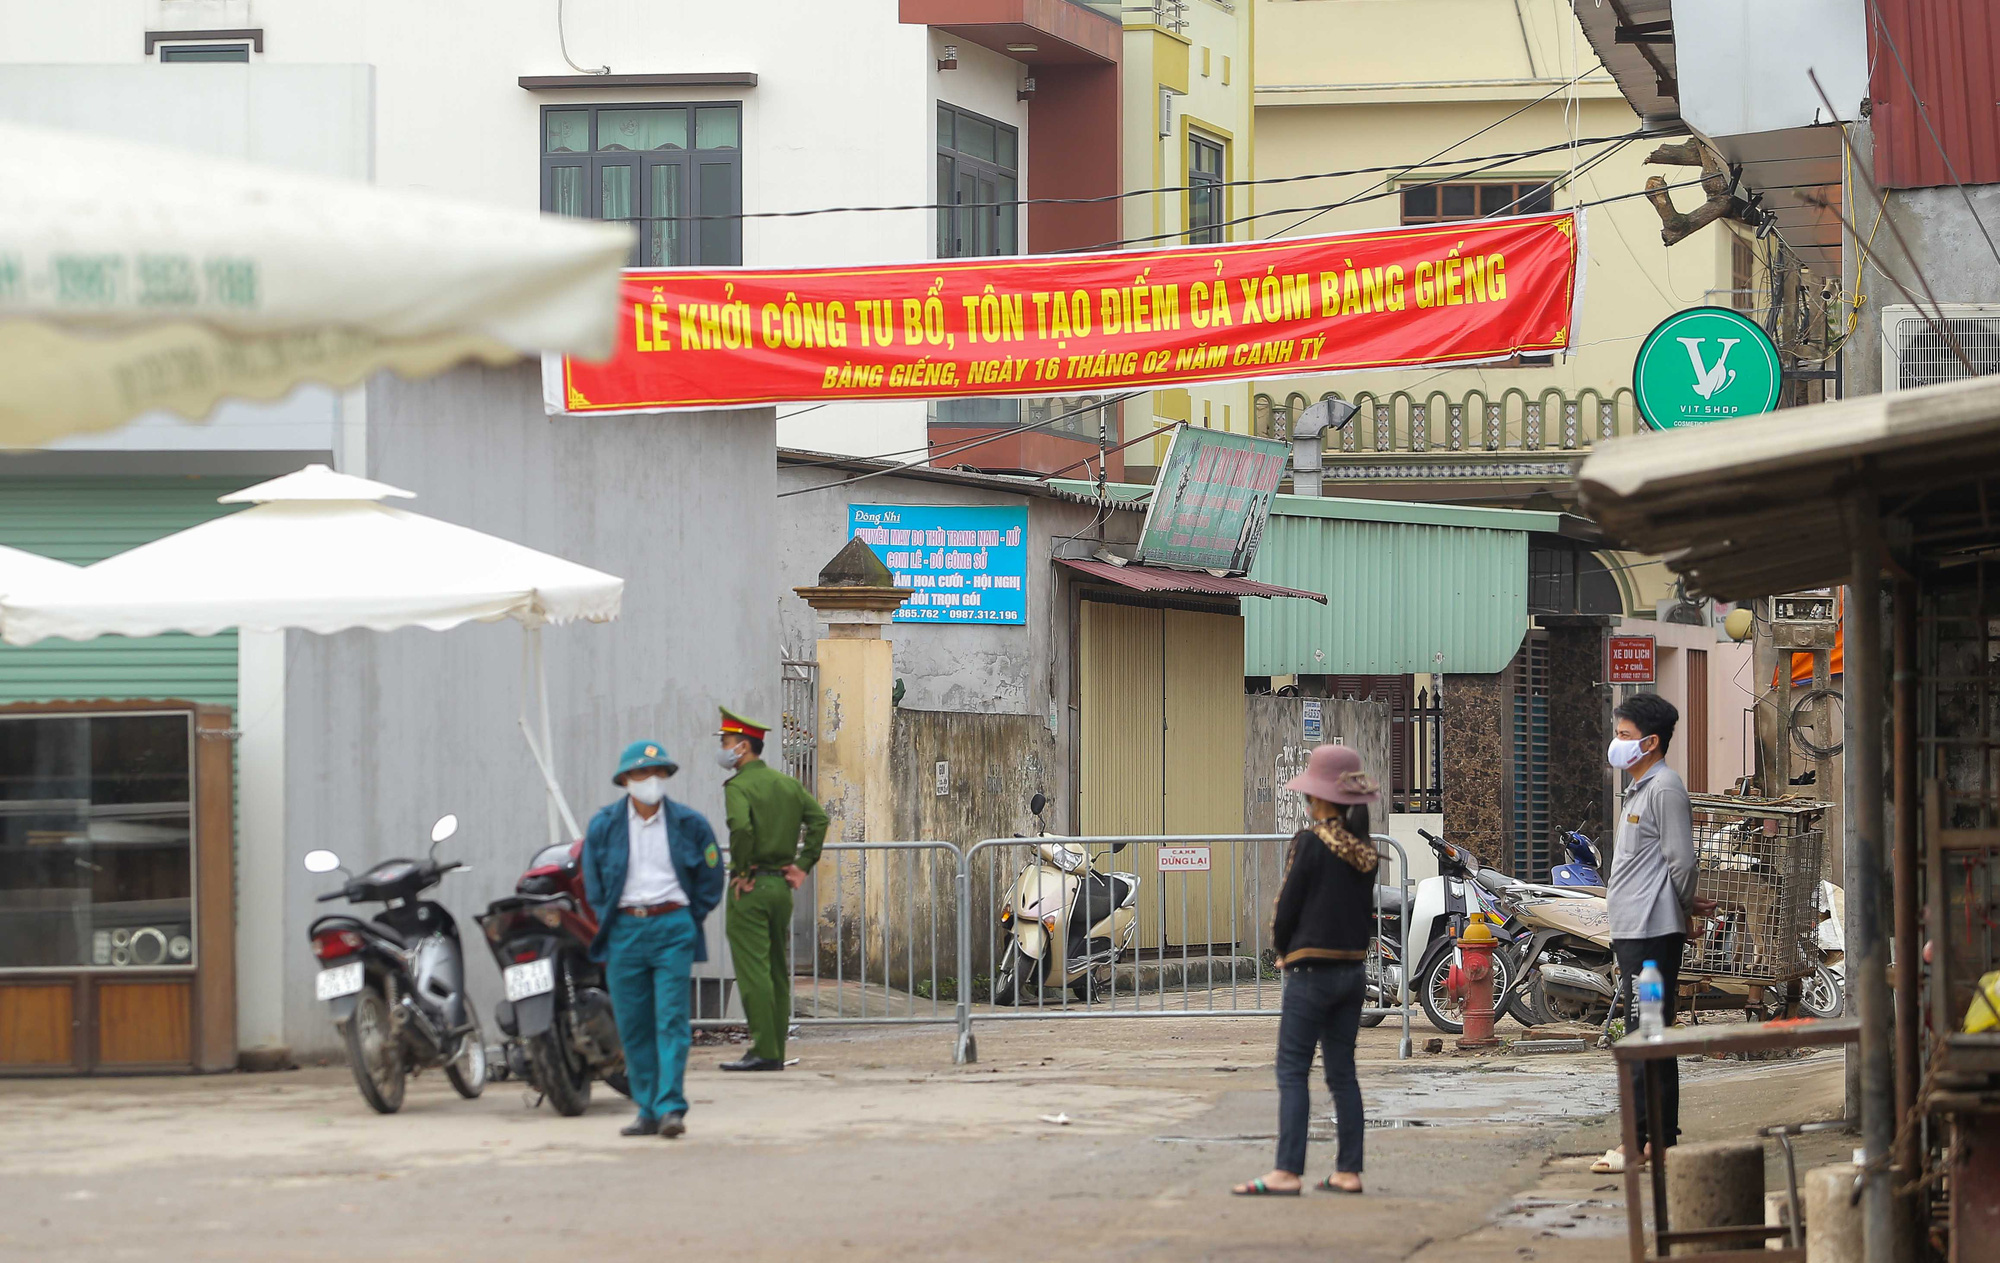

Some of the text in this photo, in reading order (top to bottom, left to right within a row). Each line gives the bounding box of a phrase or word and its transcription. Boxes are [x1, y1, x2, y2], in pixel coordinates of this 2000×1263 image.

[635, 241, 1507, 352] LỄ KHỞI CÔNG TU BỔ, TÔN TẠO ĐIẾM CẢ XÓM BÀNG GIẾNG
[822, 332, 1327, 389] BÀNG GIẾNG, NGÀY 16 THÁNG 02 NĂM CANH TÝ
[1680, 405, 1738, 414] VIT SHOP
[884, 511, 901, 522] Nhi
[890, 529, 911, 546] MAY
[925, 526, 946, 547] THỜI
[947, 530, 976, 547] TRANG
[977, 530, 999, 547] NAM
[886, 552, 909, 569] COM
[910, 549, 922, 569] LÊ
[945, 550, 972, 570] CÔNG
[973, 546, 988, 570] SỞ
[892, 571, 912, 587] ẮM
[913, 575, 936, 587] HOA
[938, 572, 964, 588] CƯỚI
[973, 573, 992, 590] HỘI
[994, 576, 1021, 591] NGHỊ
[910, 588, 929, 606] HỎI
[931, 593, 960, 608] TRỌN
[962, 591, 981, 606] GÓI
[949, 610, 1018, 620] 0987.312.196
[1613, 649, 1650, 661] XE DU LỊCH
[1161, 855, 1207, 867] DỪNG LẠI
